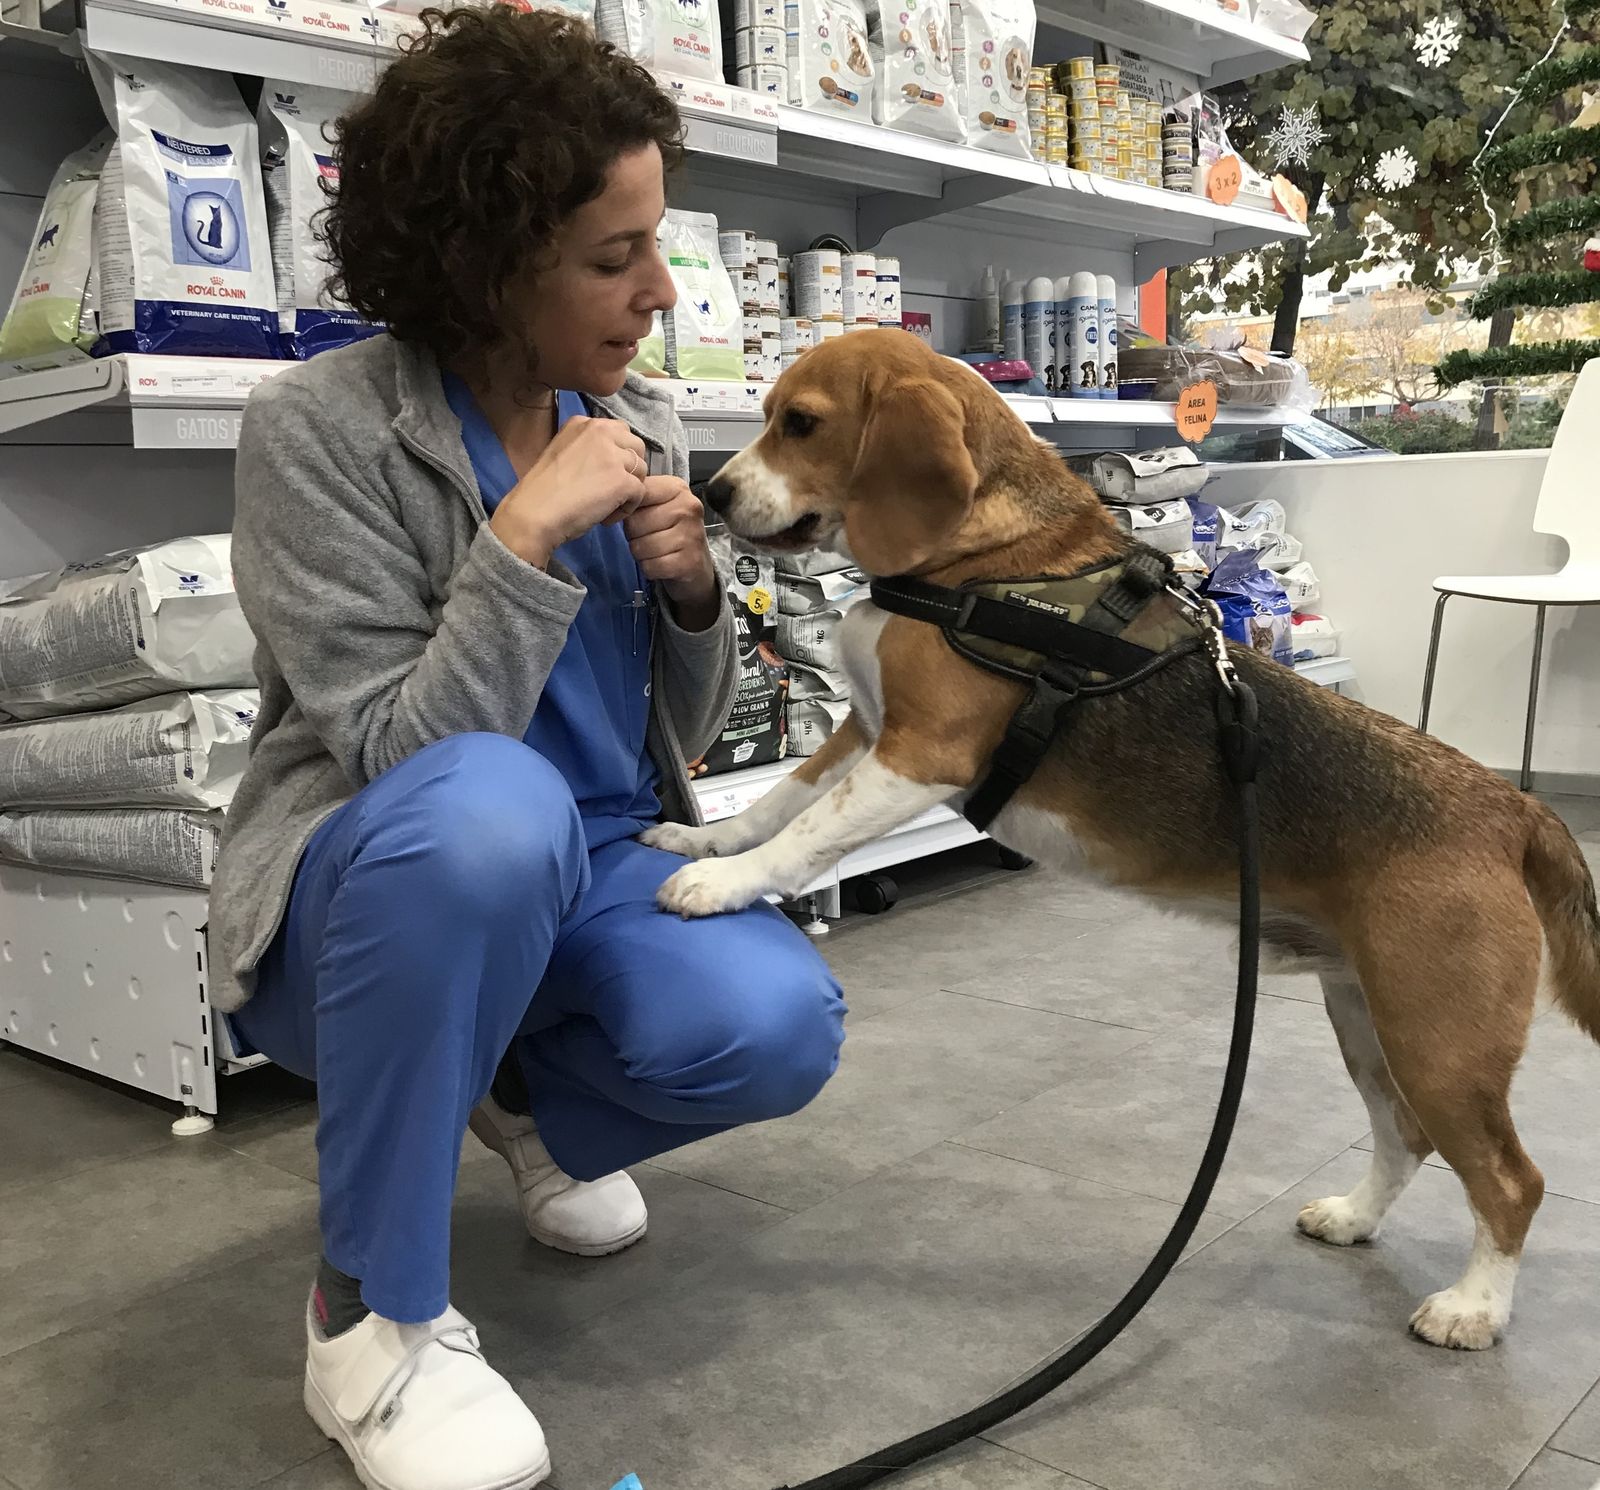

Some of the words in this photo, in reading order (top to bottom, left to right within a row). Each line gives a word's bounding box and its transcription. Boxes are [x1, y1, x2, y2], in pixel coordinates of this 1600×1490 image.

[229, 2, 254, 14] CANIN
[303, 16, 326, 28] ROYAL
[327, 19, 350, 32] CANIN
[673, 37, 693, 50] ROYAL
[693, 43, 710, 55] CANIN
[318, 55, 375, 85] PERROS
[693, 95, 708, 105] ROYAL
[708, 97, 725, 107] CANIN
[753, 107, 767, 116] ROYAL
[166, 137, 211, 155] NEUTERED
[1215, 177, 1222, 190] 3
[1232, 172, 1237, 185] 2
[187, 284, 217, 297] ROYAL
[219, 287, 246, 299] CANIN
[171, 309, 213, 318] VETERINARY
[231, 314, 261, 322] NUTRITION
[1187, 398, 1206, 409] AREA
[1184, 413, 1207, 425] FELINA
[176, 417, 229, 440] GATOS
[683, 428, 715, 444] ATITOS
[816, 629, 825, 645] 4KG
[738, 705, 749, 714] LOW
[749, 703, 765, 712] GRAIN
[803, 719, 812, 735] 4KG
